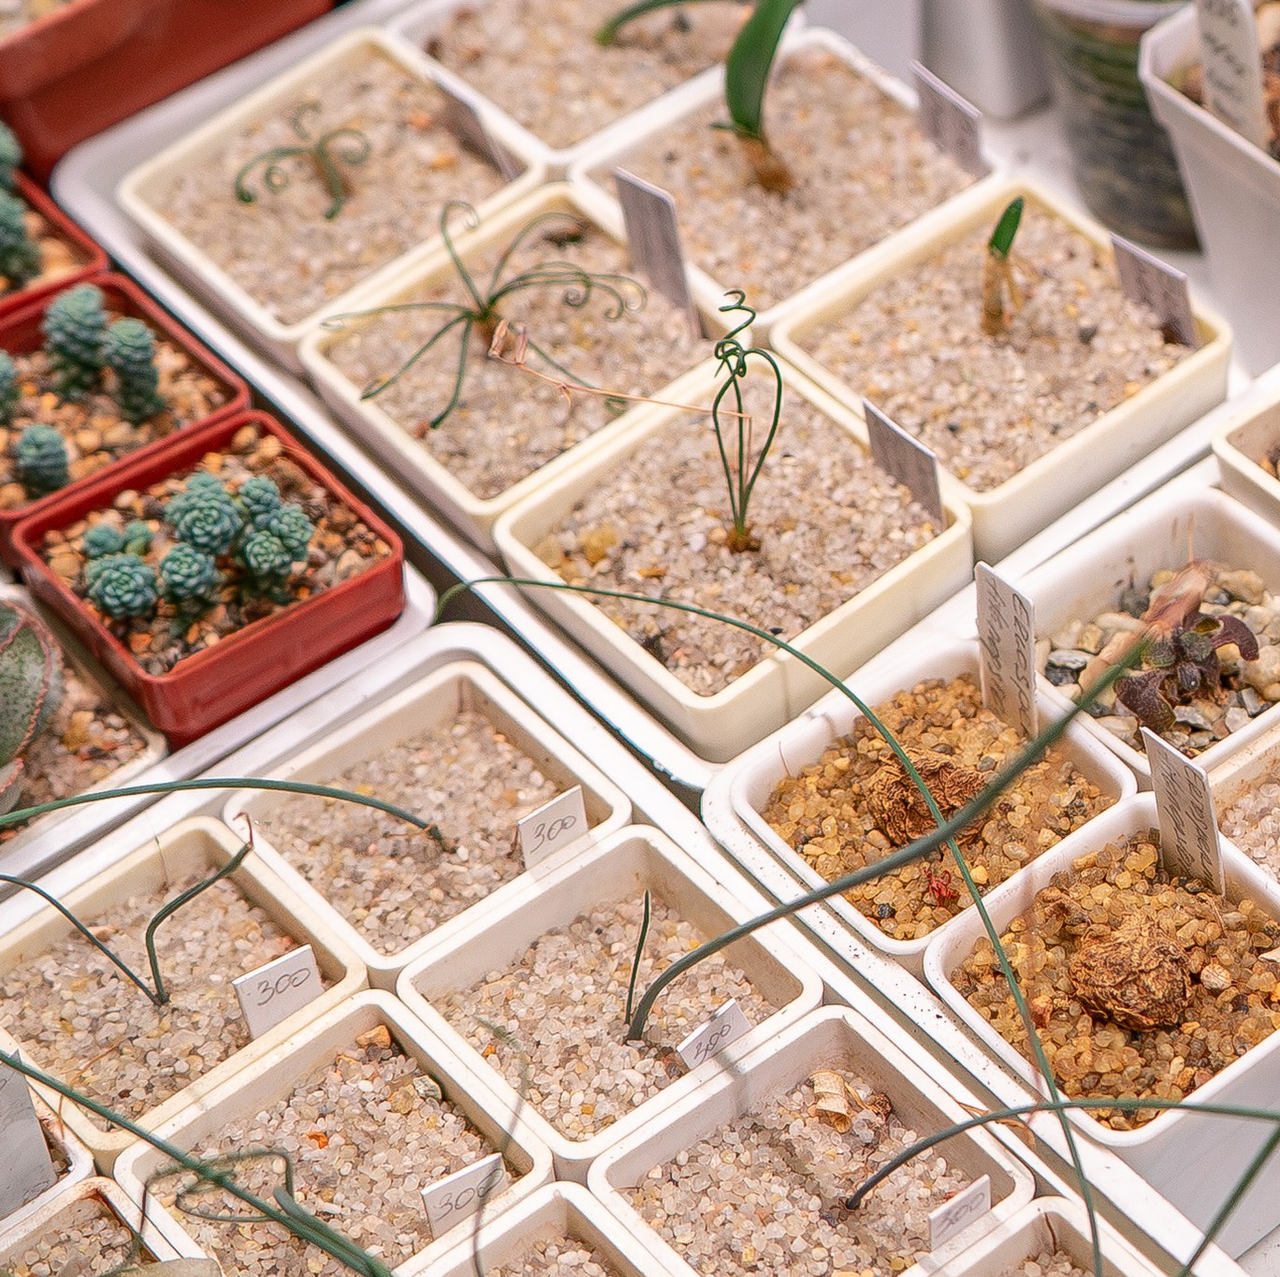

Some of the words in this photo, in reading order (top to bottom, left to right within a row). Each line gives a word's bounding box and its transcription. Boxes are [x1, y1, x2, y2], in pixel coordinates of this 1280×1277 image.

[530, 815, 577, 855] 300
[257, 967, 311, 1006] 300
[692, 1024, 732, 1062] 300
[434, 1168, 504, 1222] 300
